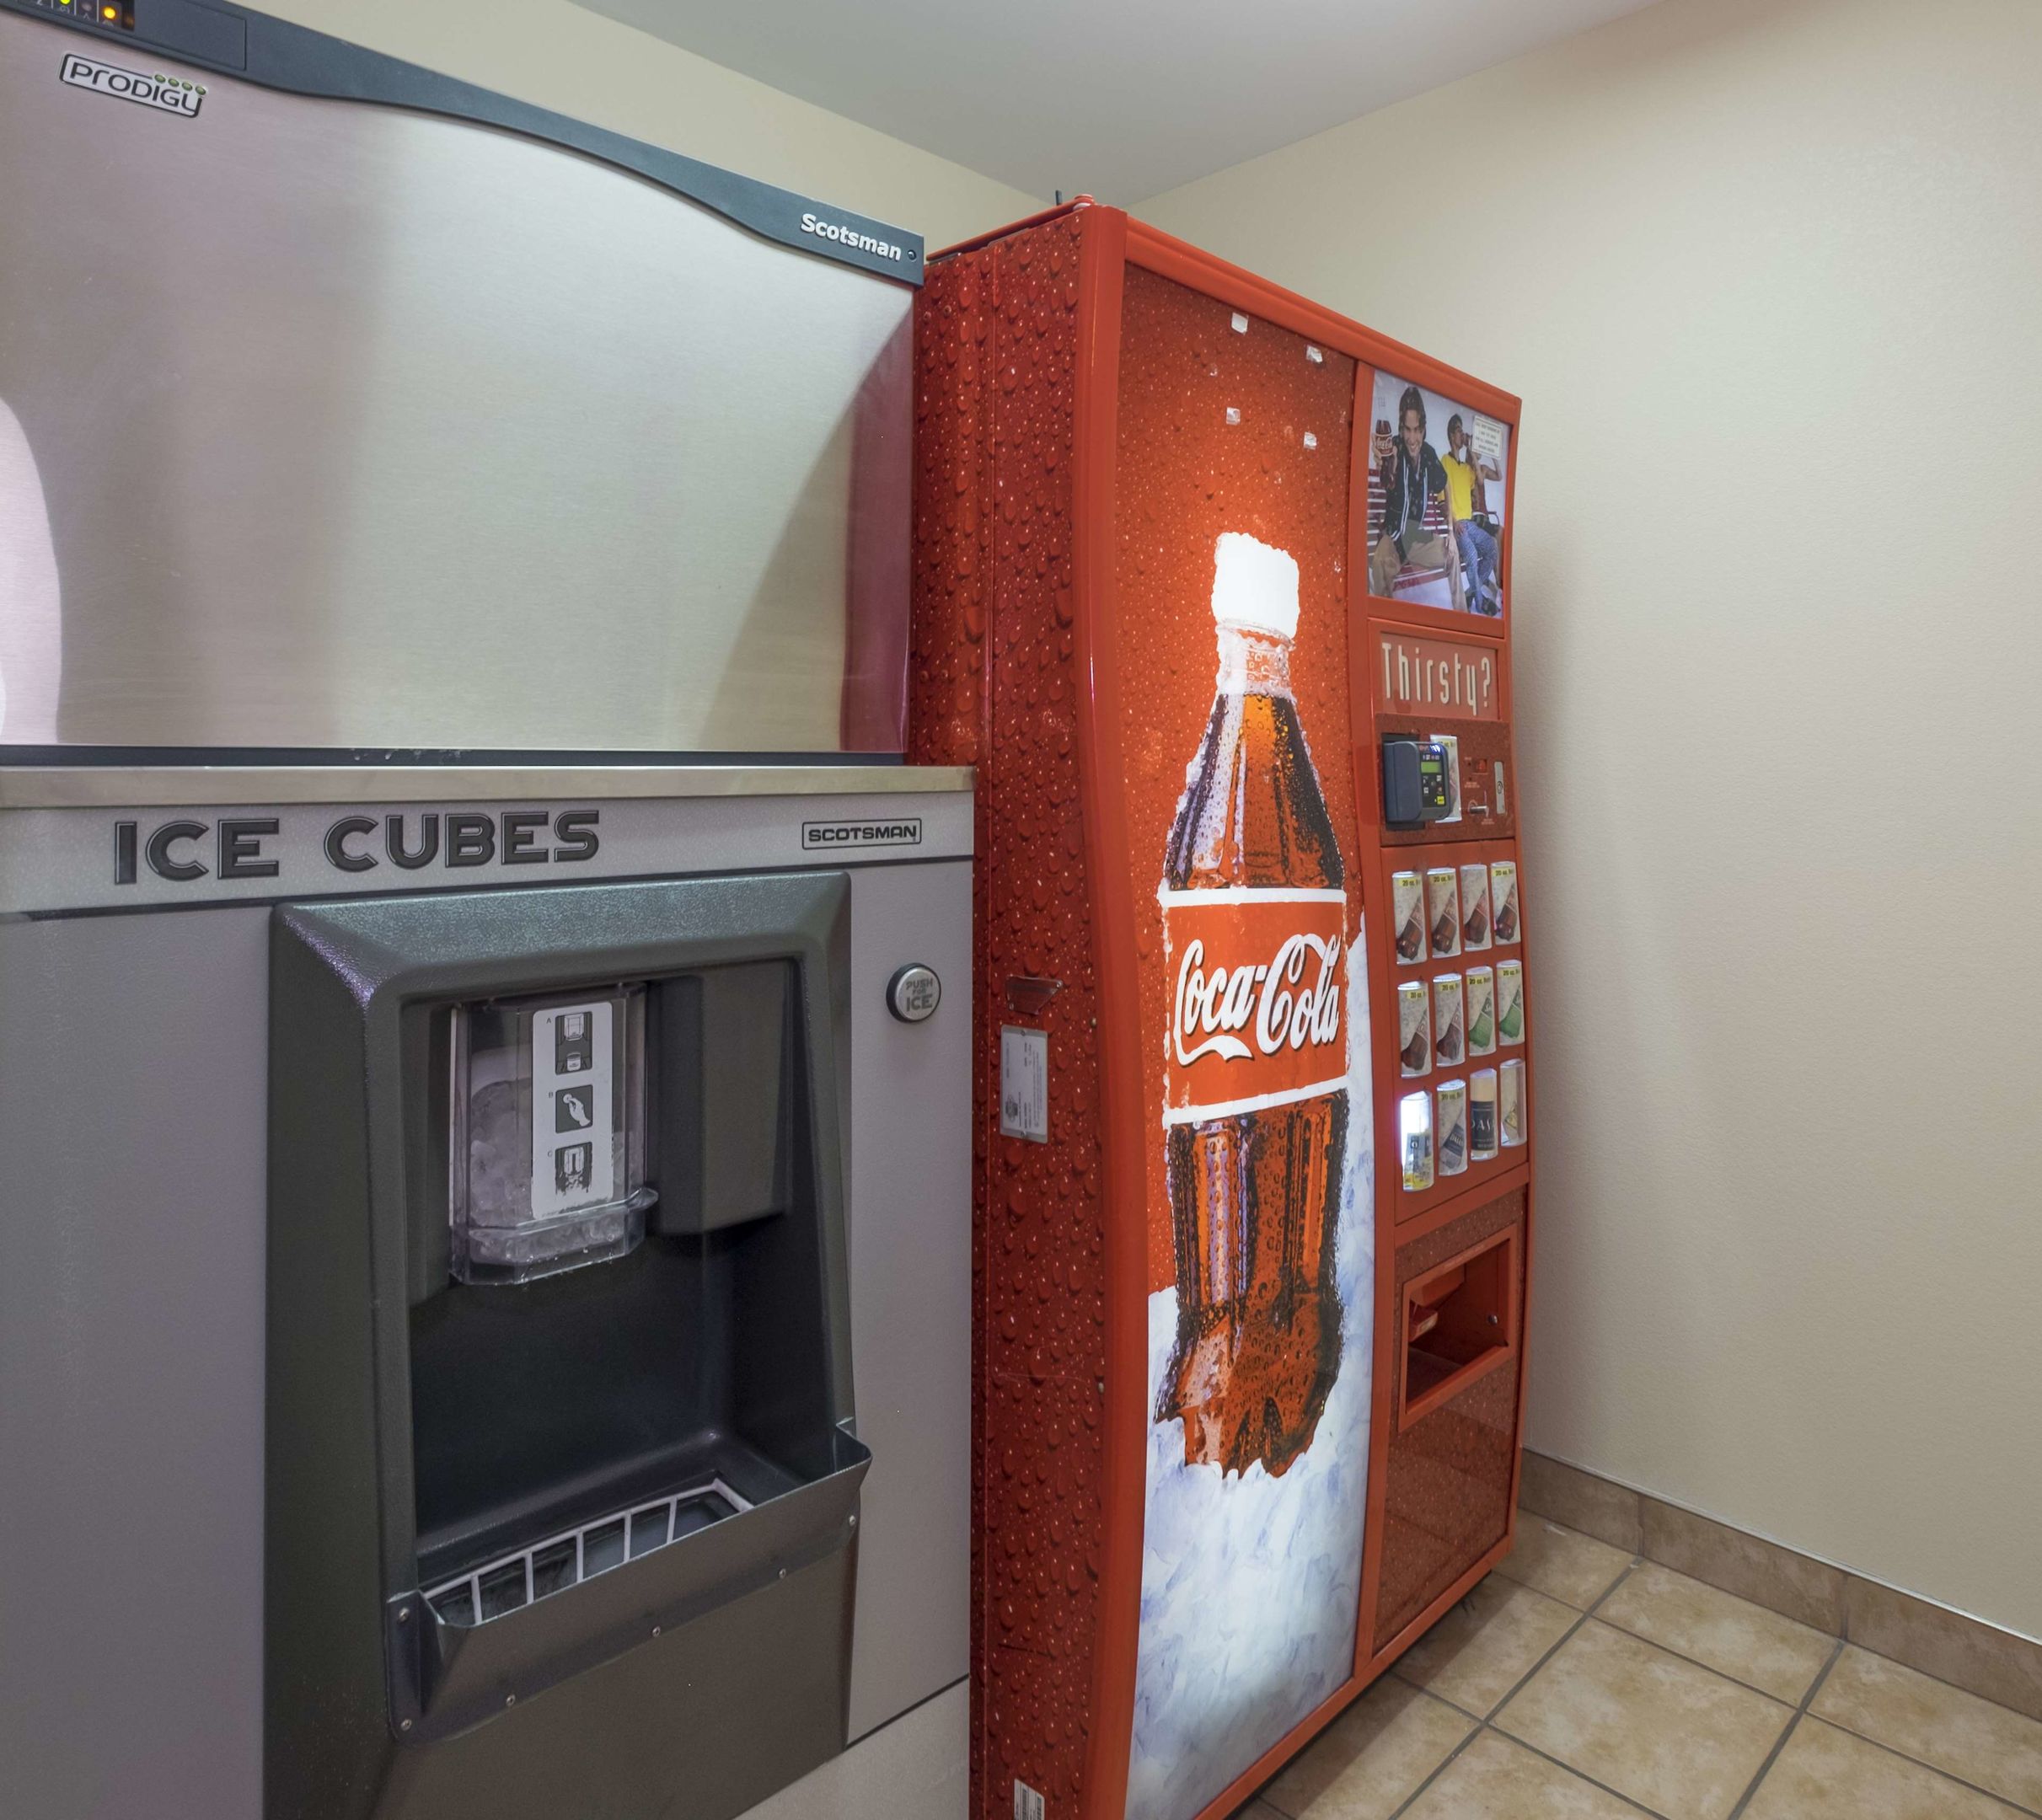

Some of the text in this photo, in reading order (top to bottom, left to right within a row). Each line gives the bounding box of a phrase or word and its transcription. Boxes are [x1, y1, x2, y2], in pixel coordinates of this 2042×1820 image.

[801, 213, 902, 260] Scotsman
[1382, 642, 1491, 716] Thirsty?
[114, 810, 600, 885] ICE CUBES
[808, 825, 917, 842] SCOTSMAN
[906, 994, 933, 1012] ICE
[1173, 933, 1342, 1067] Coca-Cola
